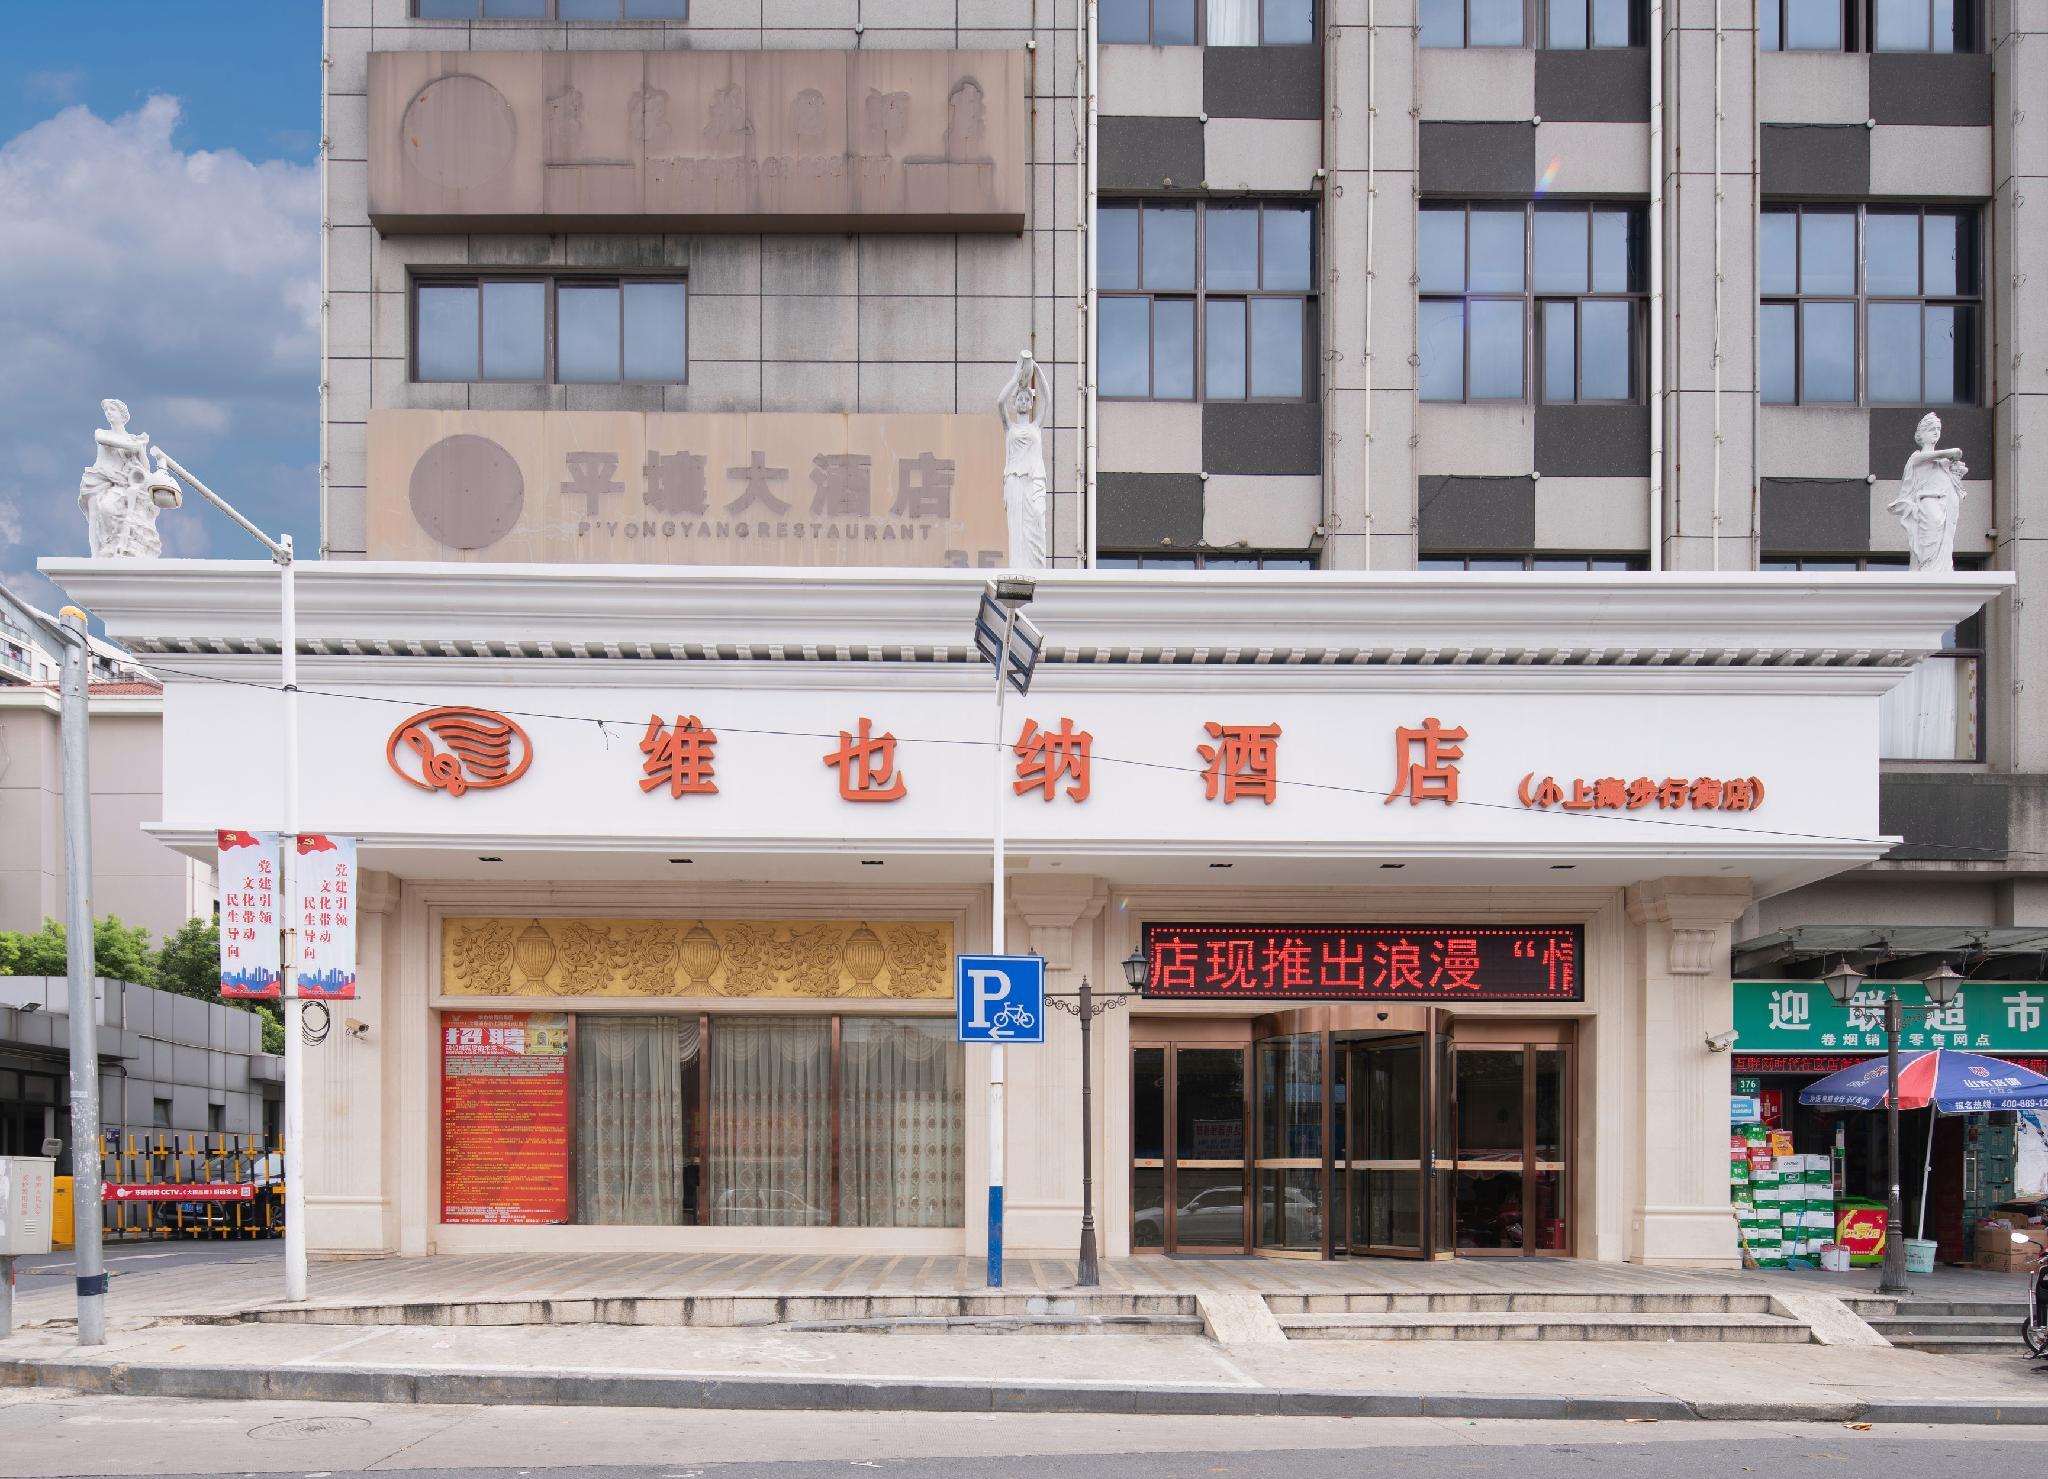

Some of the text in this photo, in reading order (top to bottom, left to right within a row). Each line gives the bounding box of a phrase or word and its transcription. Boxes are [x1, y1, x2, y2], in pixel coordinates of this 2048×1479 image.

[639, 714, 1469, 807] 维也纳酒店
[242, 876, 256, 941] 文化带动
[258, 859, 272, 924] 党建引领
[319, 879, 332, 943] 文化带动
[335, 863, 349, 927] 党建引领
[227, 893, 240, 958] 民生导向
[304, 896, 316, 960] 民生导向
[968, 969, 1012, 1028] P
[1821, 1033, 1991, 1047] 卷烟销零售网点
[1740, 1080, 1756, 1088] 376
